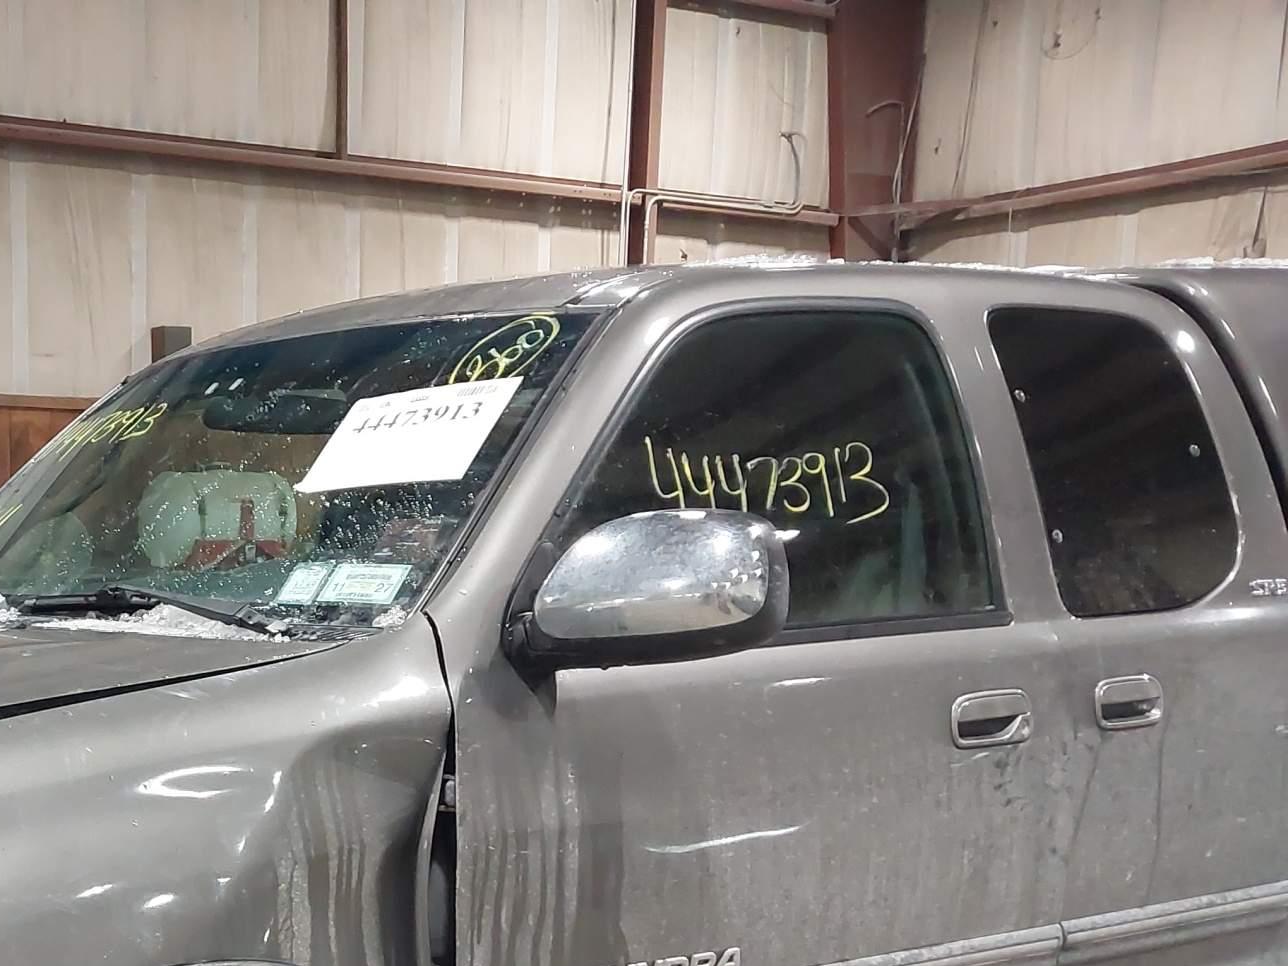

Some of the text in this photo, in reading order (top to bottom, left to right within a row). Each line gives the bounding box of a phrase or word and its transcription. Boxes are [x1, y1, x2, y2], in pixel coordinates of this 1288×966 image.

[352, 401, 483, 434] 44473913
[645, 435, 890, 525] 44473913
[373, 582, 395, 594] 27
